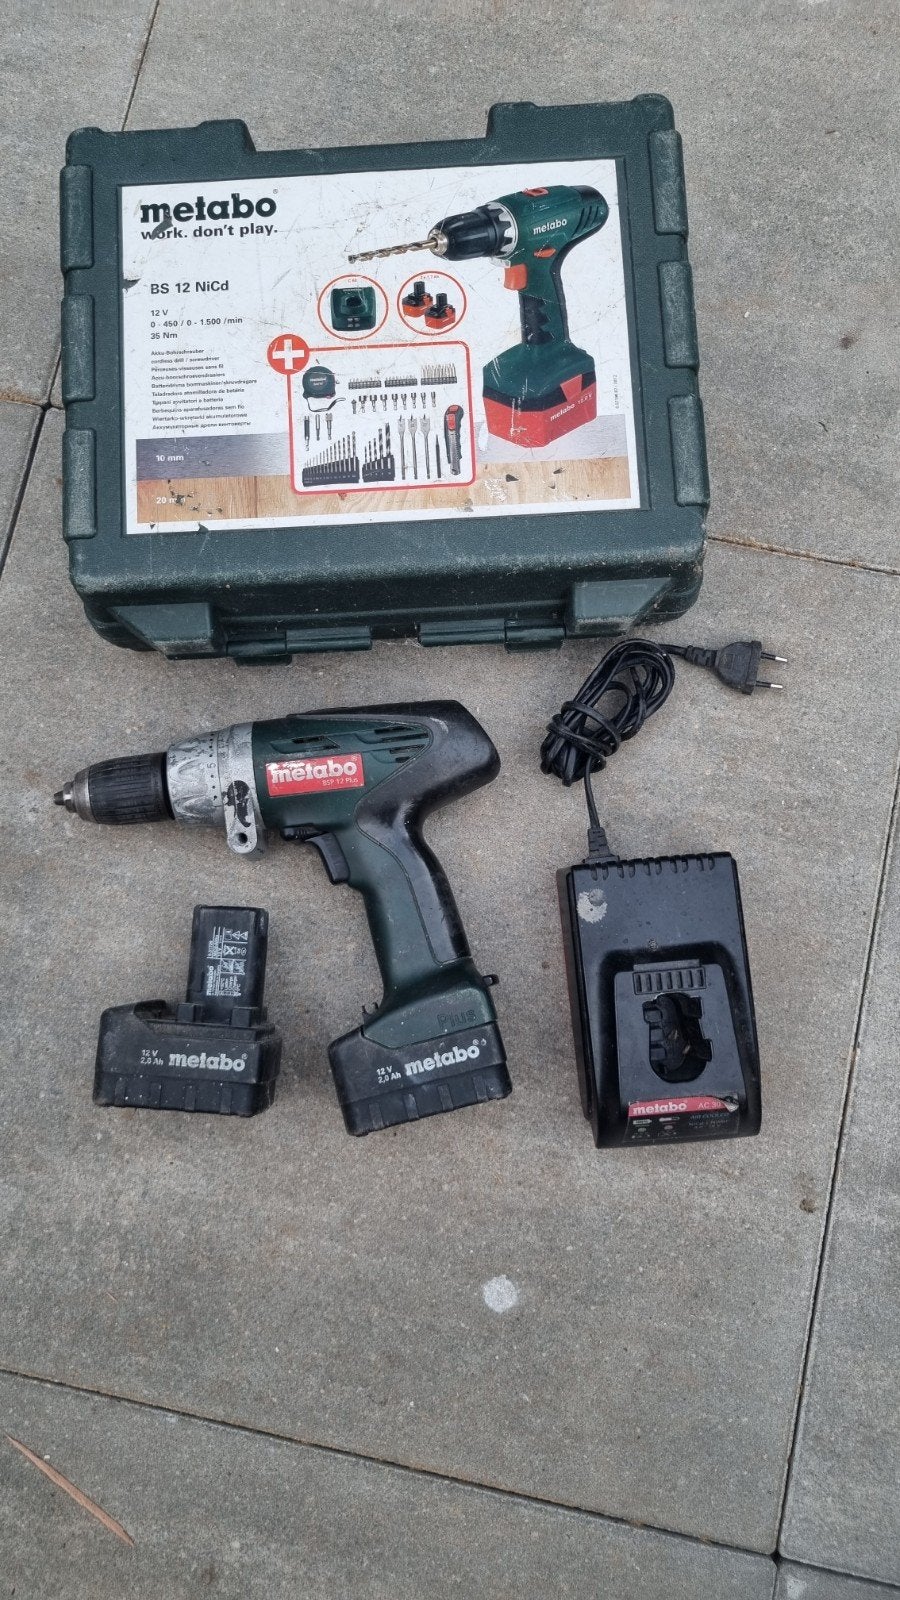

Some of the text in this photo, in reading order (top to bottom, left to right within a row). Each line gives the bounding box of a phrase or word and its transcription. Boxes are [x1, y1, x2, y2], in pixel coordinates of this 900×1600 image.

[140, 193, 276, 223] metabo
[193, 225, 234, 237] don't
[240, 223, 277, 237] play.
[532, 218, 568, 235] metabo
[151, 280, 229, 294] BS 12 NiCd
[550, 403, 575, 422] metabo
[271, 760, 357, 784] metabo
[437, 1009, 477, 1029] Plus
[168, 1052, 246, 1072] metabo
[405, 1045, 480, 1076] metabo
[378, 1073, 401, 1084] 2,0 Ah
[633, 1102, 687, 1114] metabo
